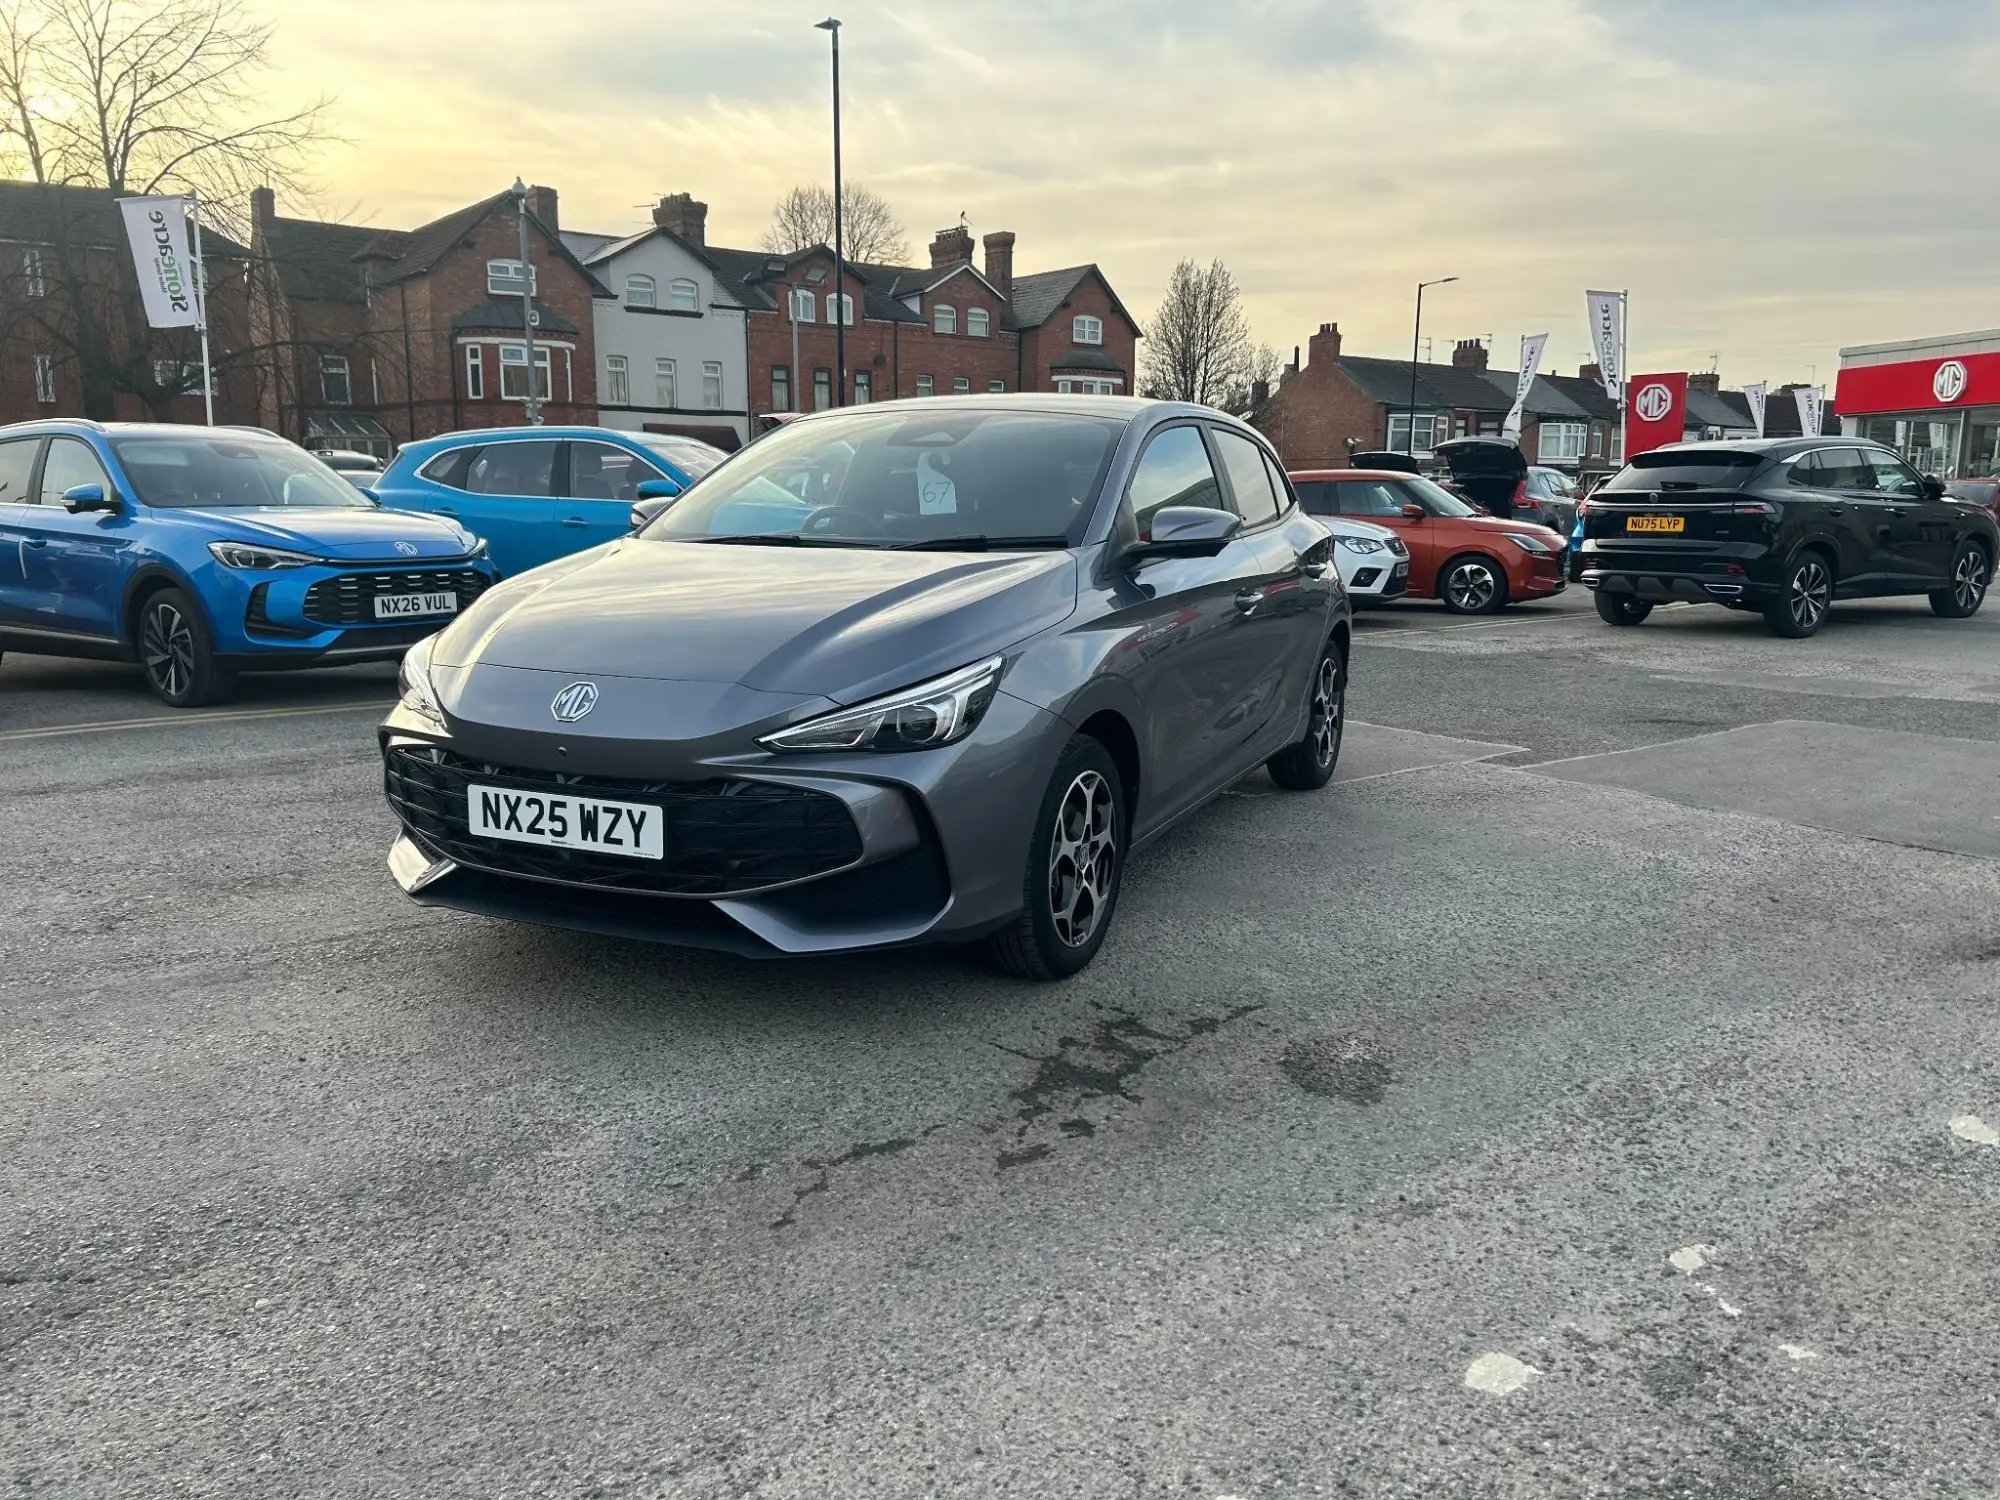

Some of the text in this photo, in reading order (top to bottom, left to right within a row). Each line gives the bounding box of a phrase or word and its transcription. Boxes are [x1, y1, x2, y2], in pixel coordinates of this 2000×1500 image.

[923, 481, 951, 505] 67
[1631, 518, 1680, 529] NU75 LYP
[381, 595, 451, 614] NX26 VUL
[555, 685, 595, 718] MG
[481, 791, 647, 848] NX25 WZY
